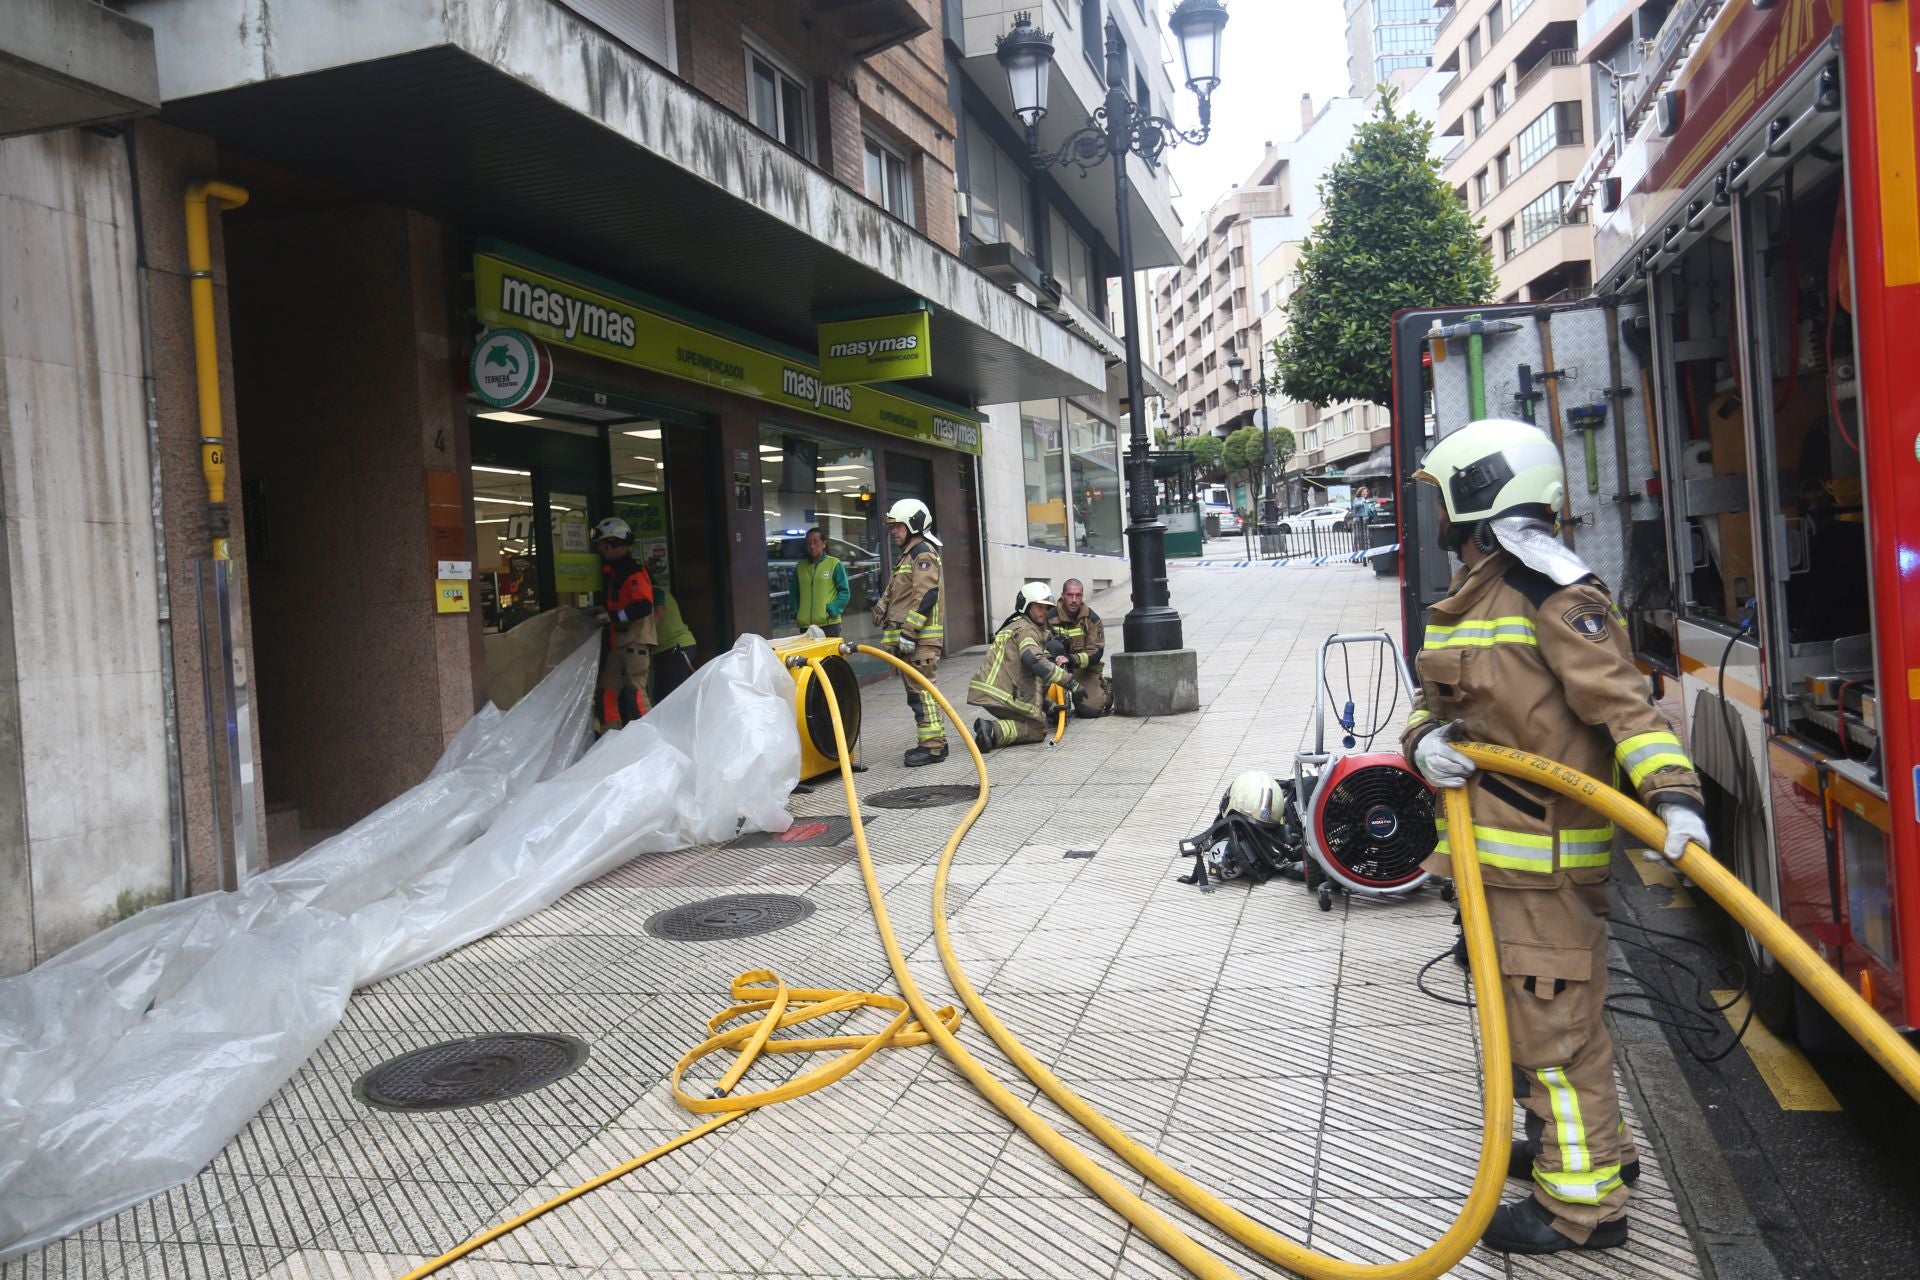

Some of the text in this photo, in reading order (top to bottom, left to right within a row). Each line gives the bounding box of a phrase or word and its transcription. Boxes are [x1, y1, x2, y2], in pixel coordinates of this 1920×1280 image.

[502, 276, 636, 348] masymas
[830, 334, 918, 357] masymas
[676, 346, 745, 380] SUPERMERCADOS
[484, 374, 511, 384] TERNERA
[783, 369, 852, 411] masymas
[435, 429, 445, 453] 4
[933, 416, 977, 445] masymas
[1530, 757, 1550, 770] 220
